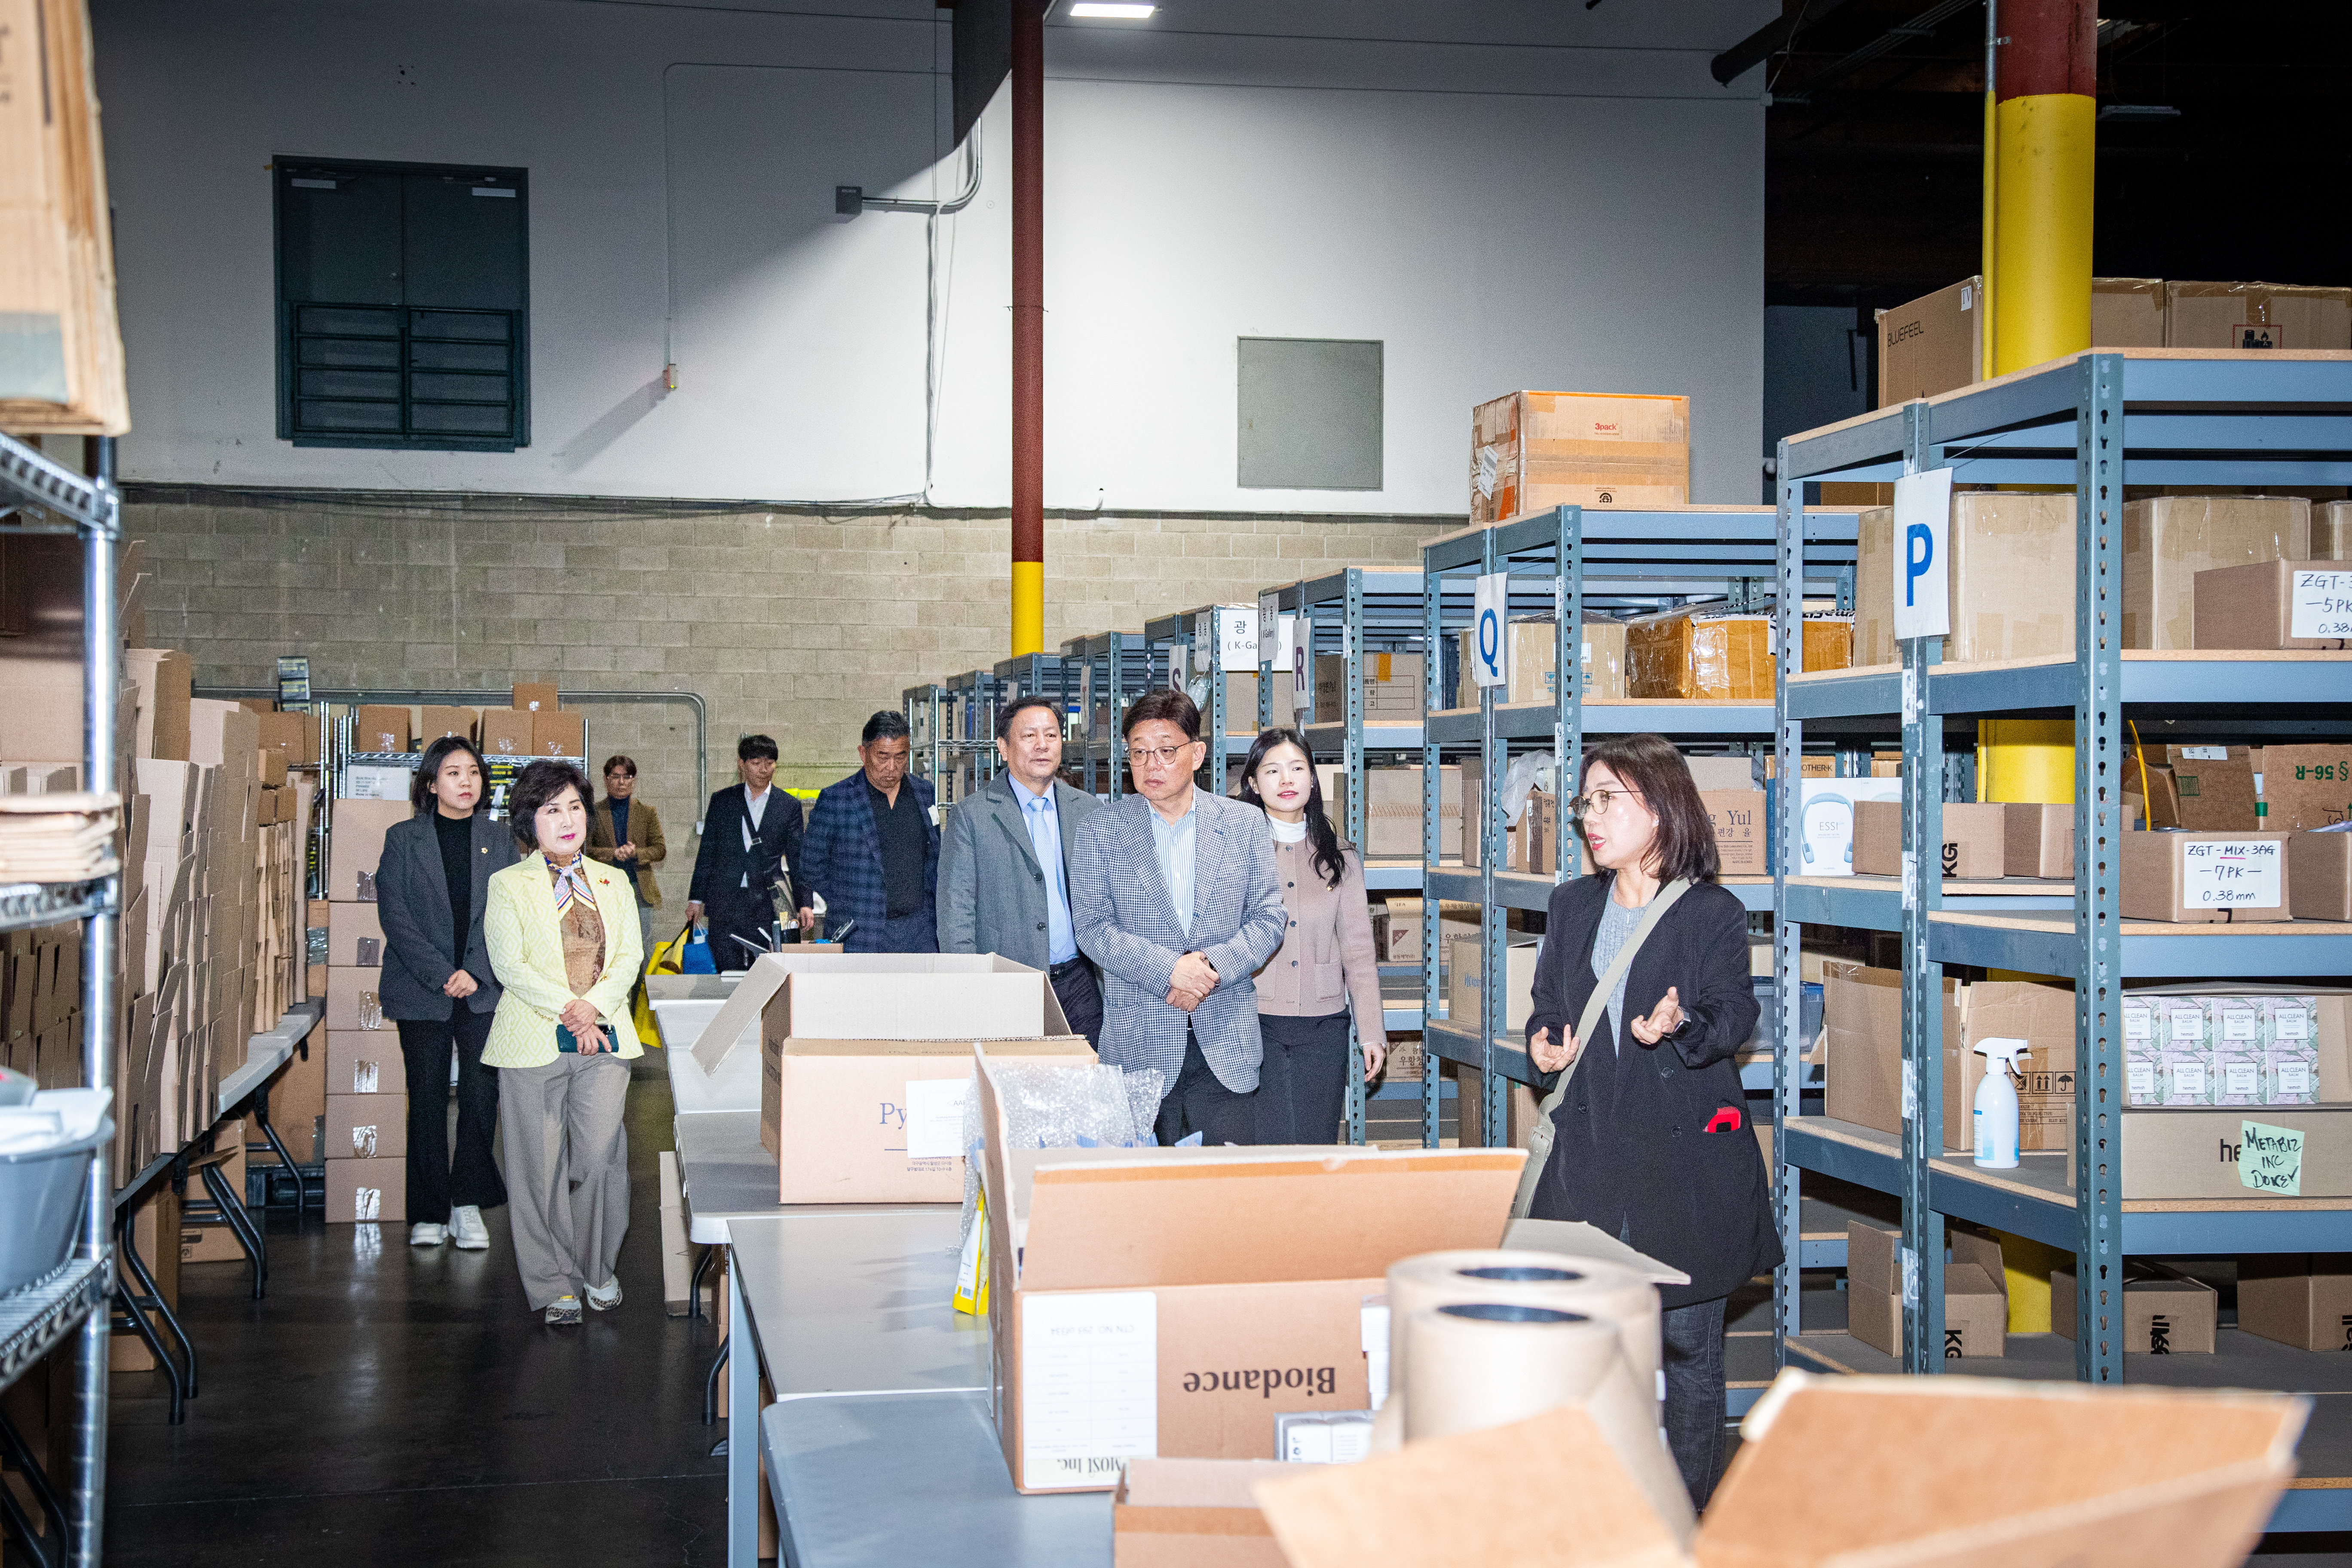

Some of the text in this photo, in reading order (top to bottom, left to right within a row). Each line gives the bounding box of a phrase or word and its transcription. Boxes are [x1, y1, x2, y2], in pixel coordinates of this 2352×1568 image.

[1961, 288, 1971, 304] TV
[1888, 321, 1924, 347] BLUEFEEL
[1595, 423, 1617, 431] 3pack
[1907, 524, 1933, 606] P
[1234, 620, 1247, 634] 광
[2318, 623, 2352, 633] 0.38
[1480, 609, 1498, 677] Q
[1296, 646, 1305, 692] R
[1727, 810, 1752, 825] Yul
[1819, 822, 1838, 831] ESSI
[1718, 827, 1751, 837] 편강 율
[879, 1103, 907, 1130] Py
[2220, 1139, 2242, 1162] he
[1183, 1367, 1335, 1398] Biodance
